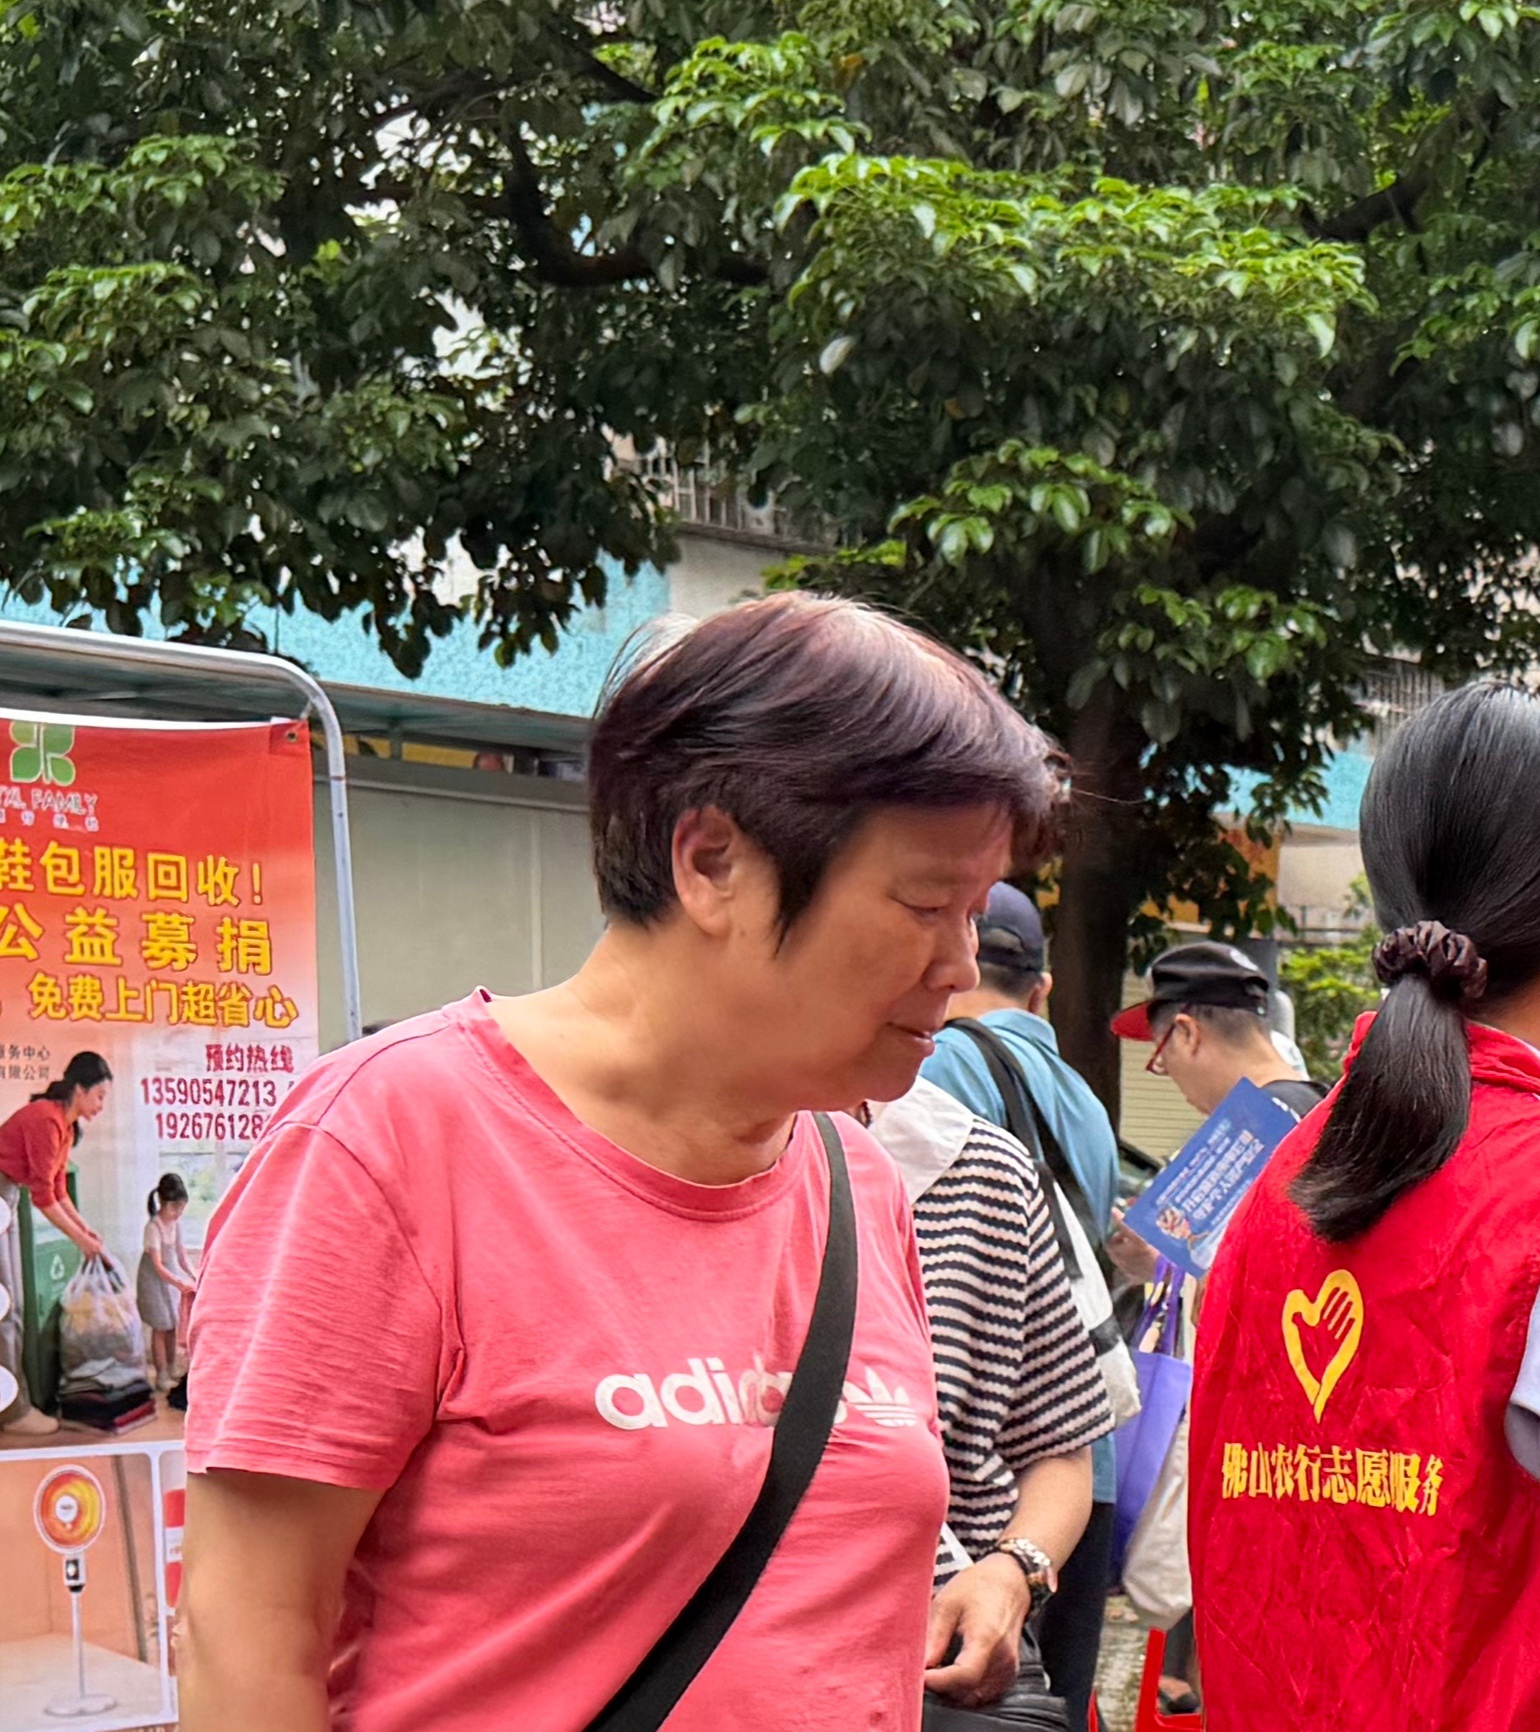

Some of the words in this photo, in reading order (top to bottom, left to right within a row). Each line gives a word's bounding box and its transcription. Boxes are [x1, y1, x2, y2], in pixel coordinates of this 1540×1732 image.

[0, 900, 272, 976] 公益募捐
[28, 972, 299, 1030] 免费上门超省心
[205, 1044, 294, 1073] 预约热线
[140, 1077, 277, 1107] 13590547213
[1221, 1442, 1444, 1516] 佛山农行志愿服务
